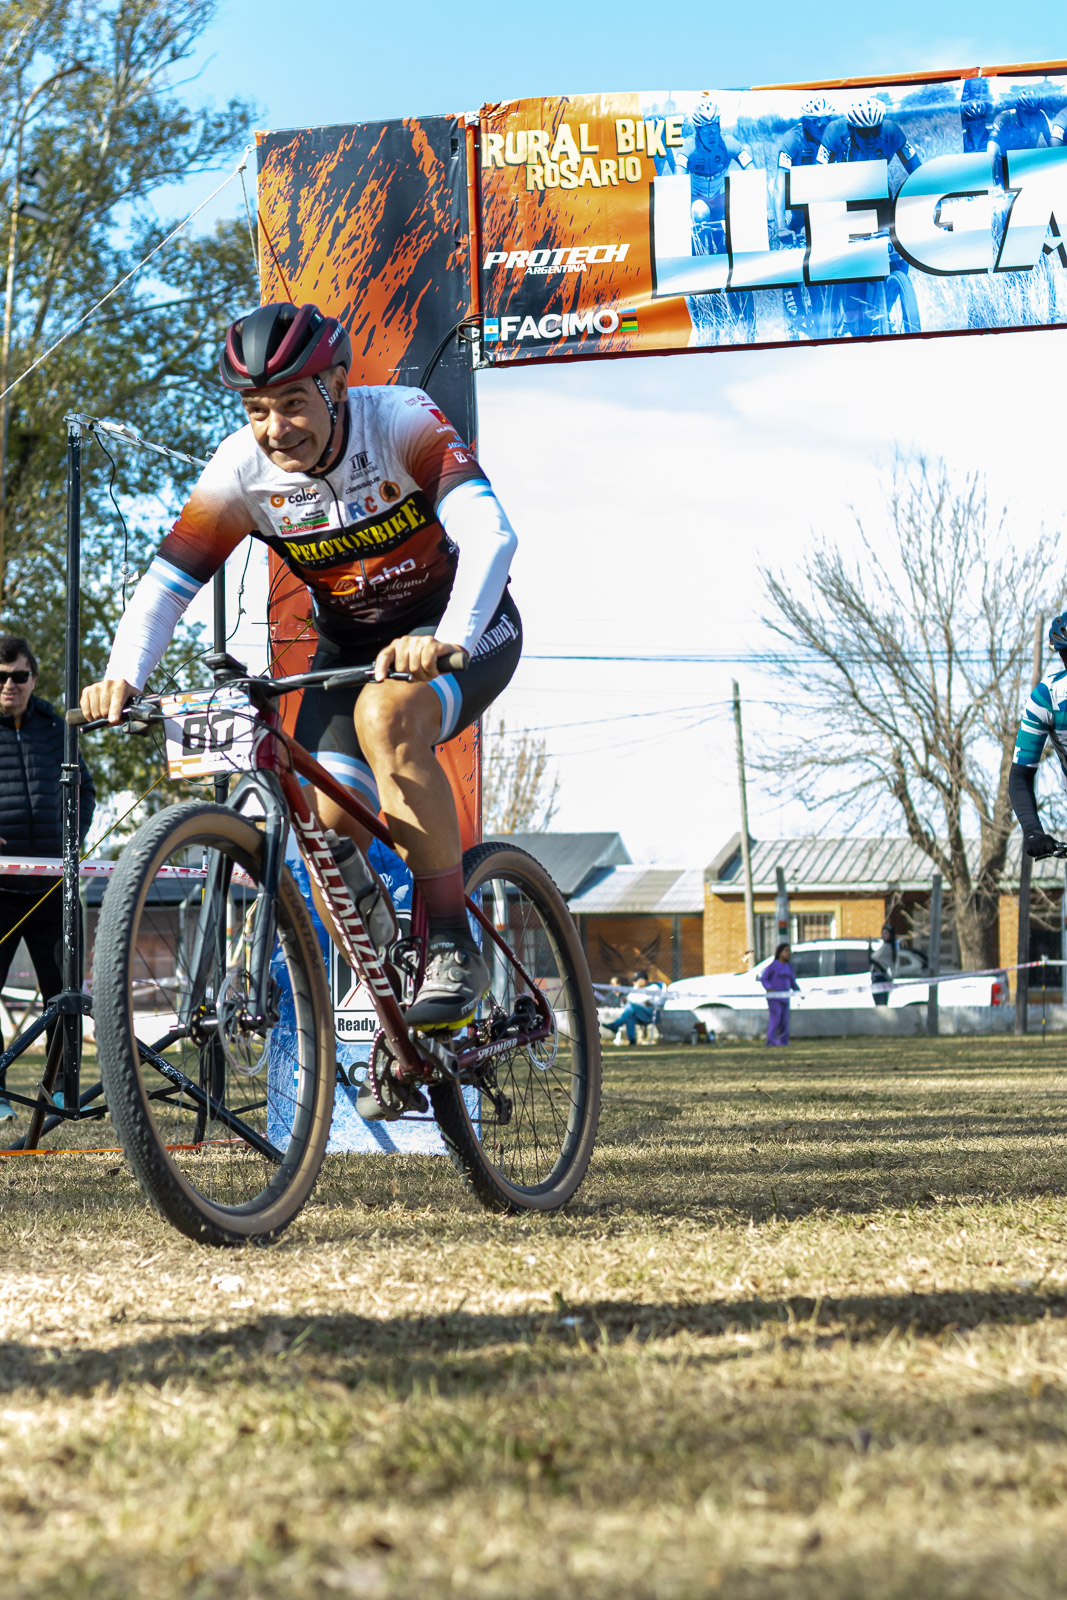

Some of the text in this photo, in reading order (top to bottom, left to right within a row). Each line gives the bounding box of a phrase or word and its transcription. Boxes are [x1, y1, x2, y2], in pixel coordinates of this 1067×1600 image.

[481, 115, 685, 168] RURAL BIKE
[526, 156, 642, 191] ROSARIO
[483, 243, 630, 269] PROTECH
[524, 264, 587, 275] ARGENTINA
[500, 309, 619, 341] FACIMO
[288, 487, 320, 504] color
[284, 498, 426, 564] PELOTONBIKE
[471, 613, 519, 658] OTONBIKE
[294, 811, 394, 997] SPECIALIZED
[337, 1017, 376, 1032] Ready
[335, 1061, 370, 1087] AC
